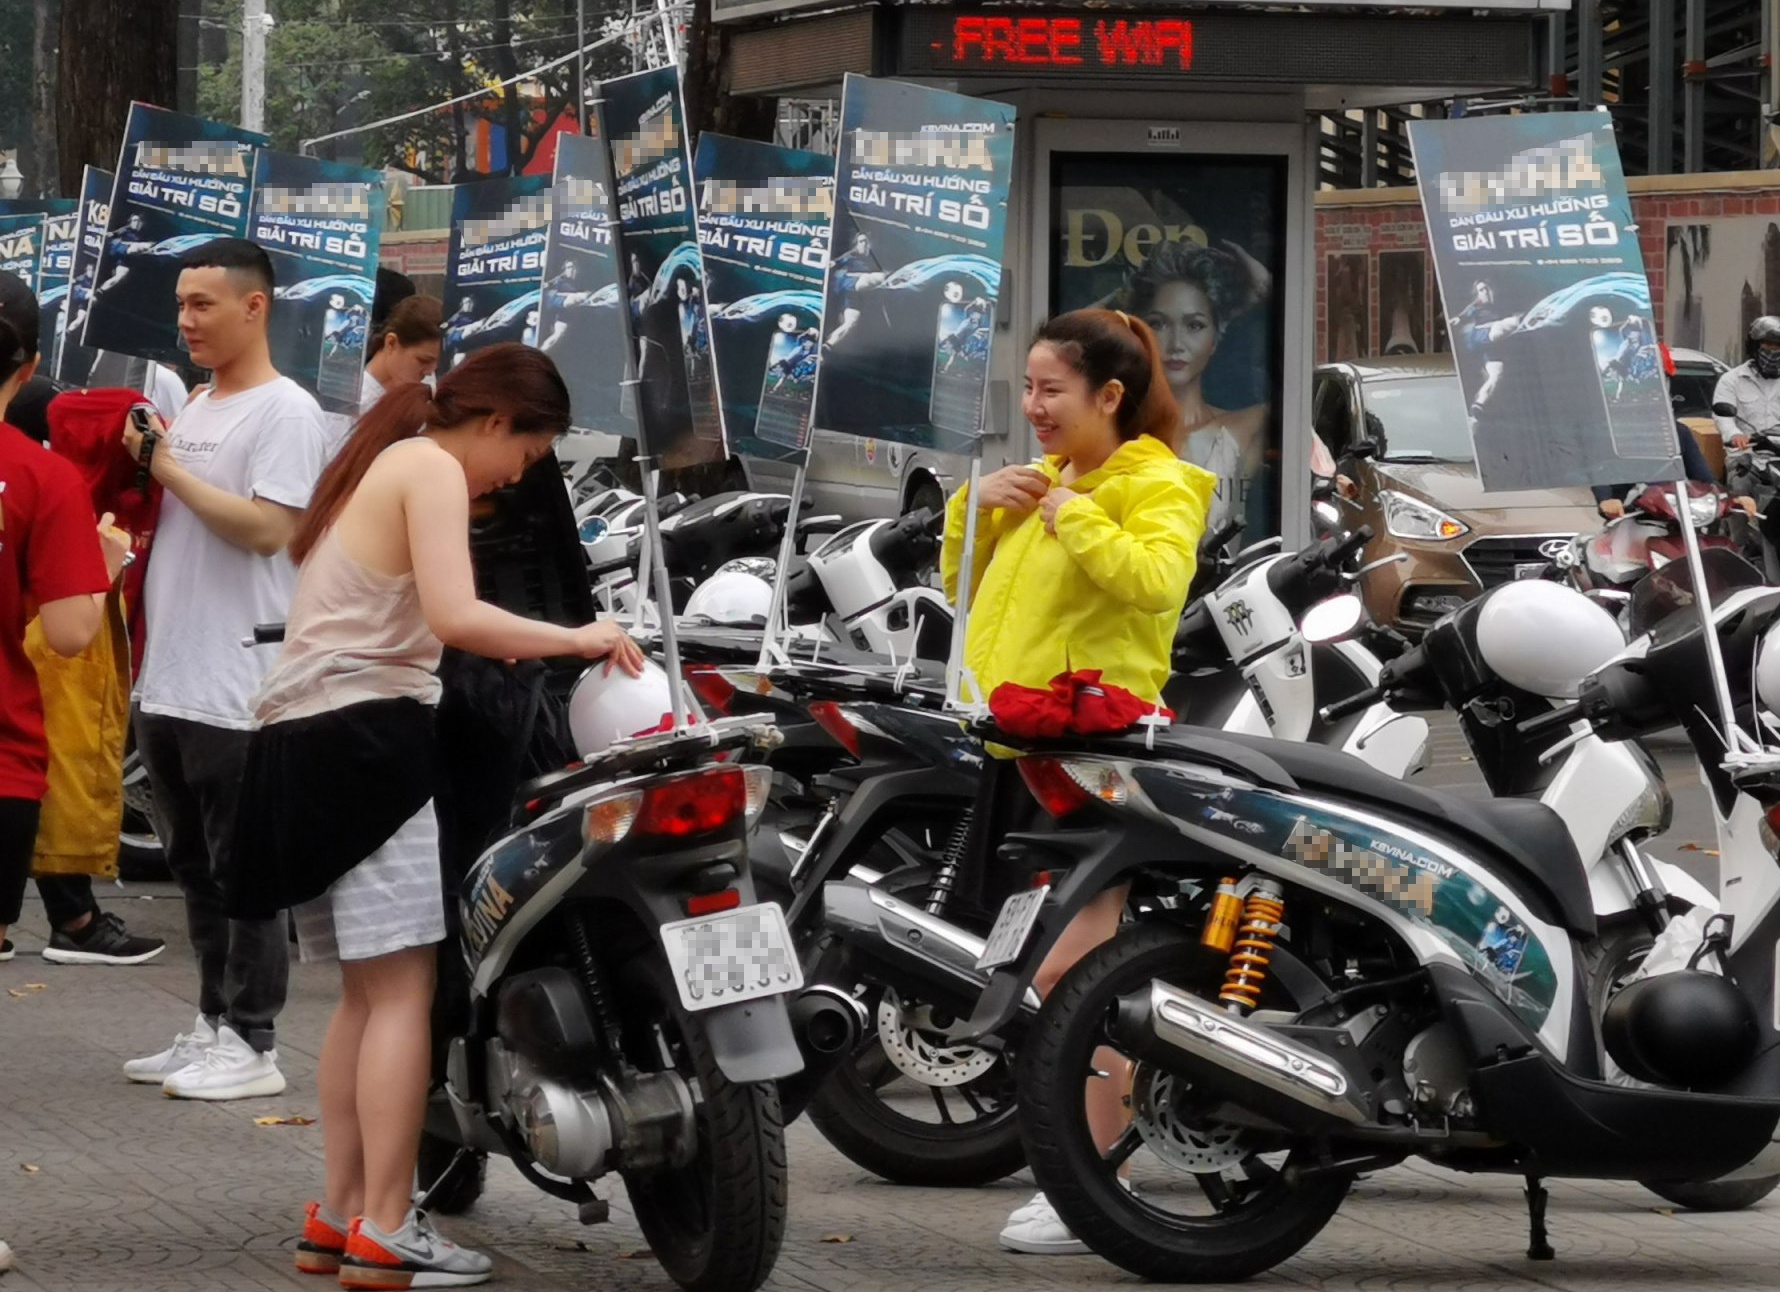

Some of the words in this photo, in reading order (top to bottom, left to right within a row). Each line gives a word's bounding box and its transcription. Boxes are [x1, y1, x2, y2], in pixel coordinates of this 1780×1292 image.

[954, 16, 1084, 64] FREE
[128, 181, 159, 198] GIẢI
[161, 188, 197, 207] TRÍ
[198, 192, 241, 218] SỐ
[901, 174, 921, 186] XU
[923, 175, 991, 194] HƯỚNG
[849, 184, 886, 207] GIẢI
[890, 192, 935, 217] TRÍ
[938, 194, 990, 230] SỐ
[1505, 206, 1528, 220] XU
[256, 226, 286, 242] GIẢI
[288, 231, 323, 249] TRÍ
[324, 233, 367, 258] SỐ
[560, 221, 589, 240] GIẢI
[1452, 227, 1496, 251] GIẢI
[1499, 220, 1550, 249] TRÍ
[1556, 210, 1619, 246] SỐ
[457, 258, 484, 276] GIẢI
[486, 251, 519, 273] TRÍ
[698, 227, 730, 248] GIẢI
[733, 235, 777, 258] TRÍ
[778, 237, 829, 269] SỐ
